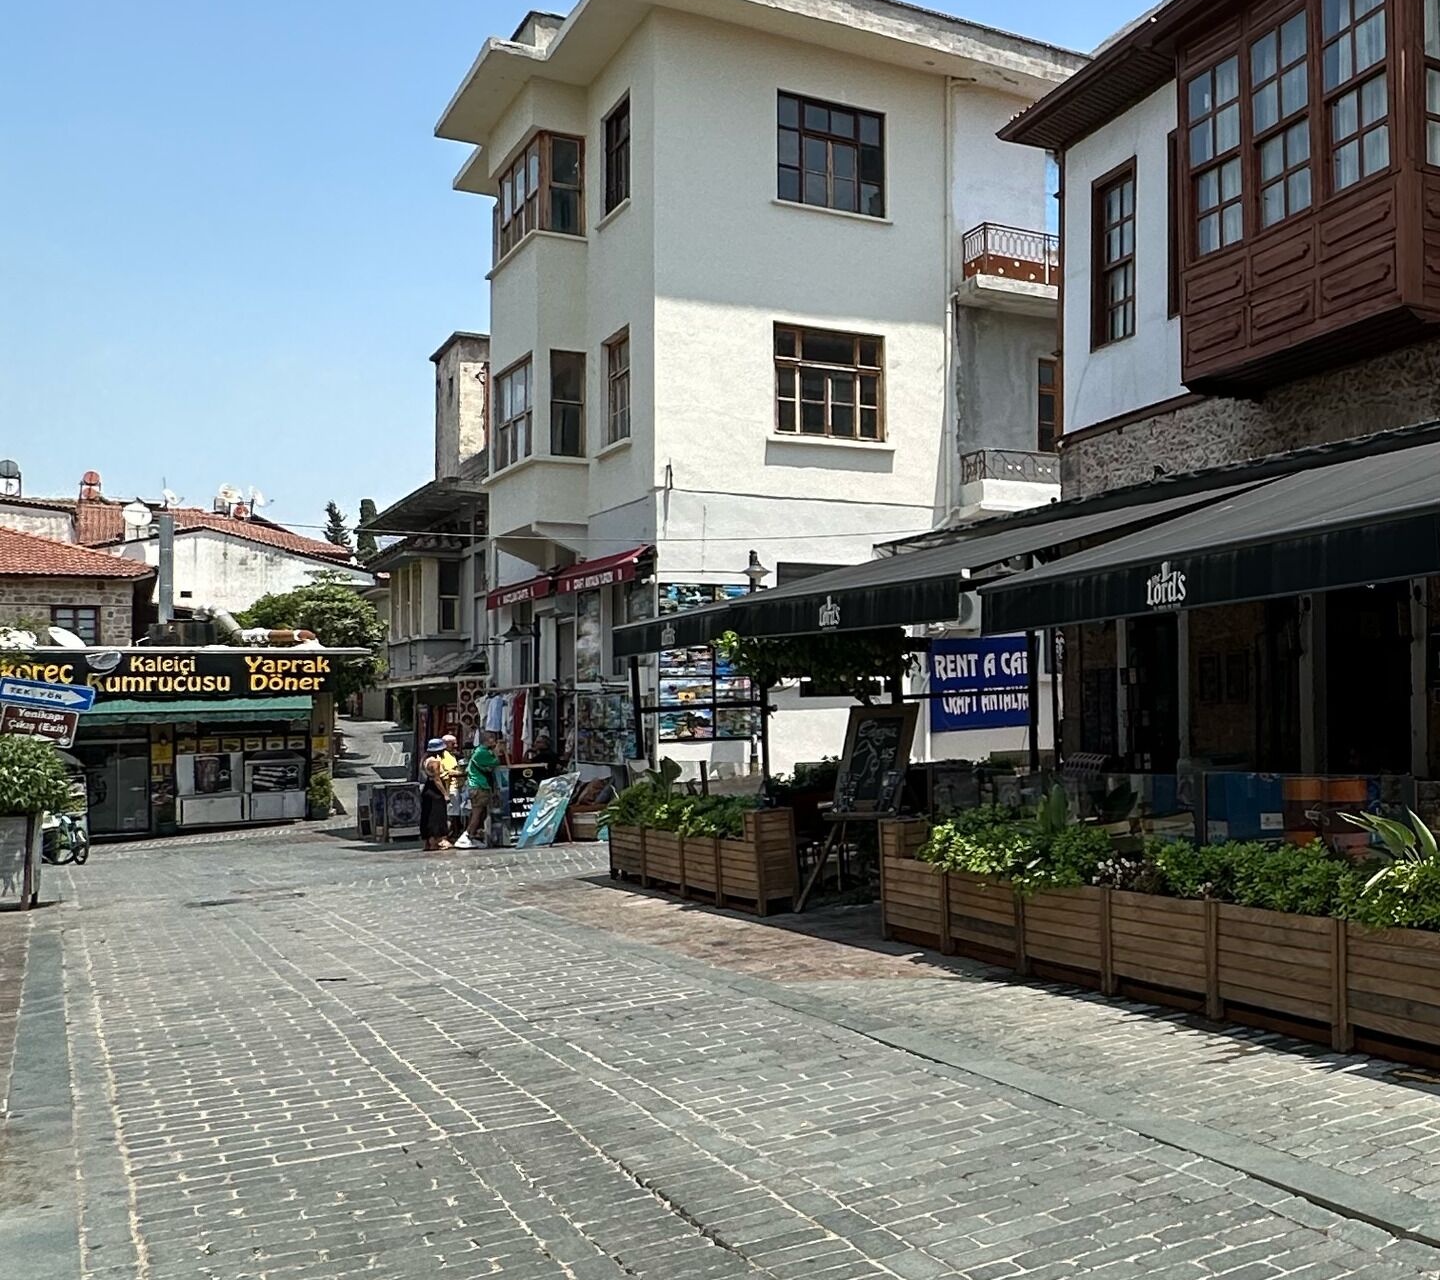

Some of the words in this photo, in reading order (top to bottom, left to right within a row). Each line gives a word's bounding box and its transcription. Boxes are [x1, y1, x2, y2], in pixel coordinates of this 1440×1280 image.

[1146, 571, 1186, 606] Lord's
[130, 655, 196, 676] Kaleiçi
[244, 655, 331, 675] Yaprak
[934, 653, 978, 681] RENT
[983, 653, 996, 678] A
[10, 686, 31, 696] TEK
[250, 673, 326, 691] Döner
[943, 688, 978, 715] CRAFT
[981, 686, 1029, 714] ANTALYA
[18, 708, 65, 722] Yenikapı
